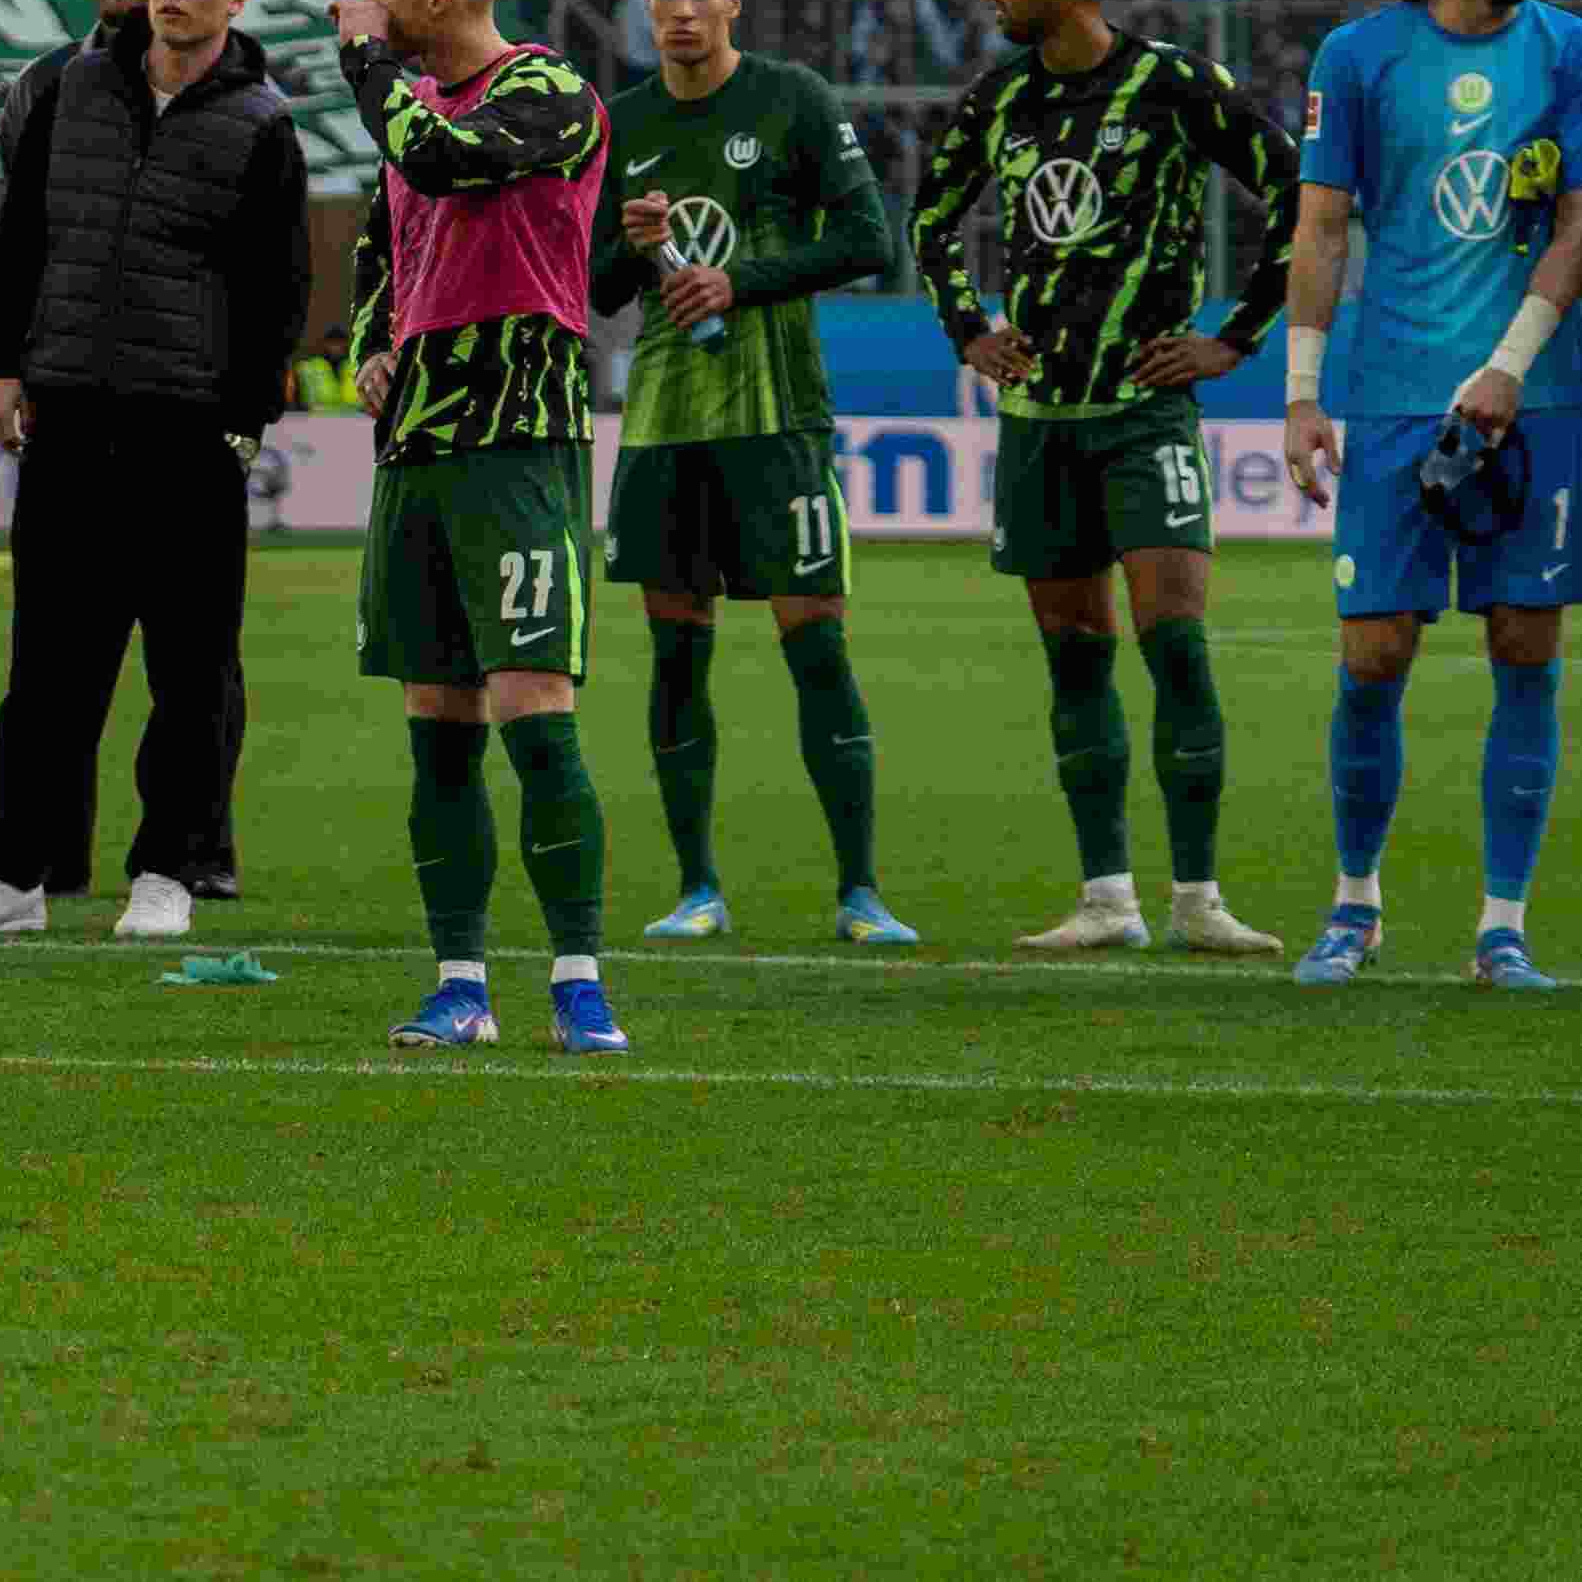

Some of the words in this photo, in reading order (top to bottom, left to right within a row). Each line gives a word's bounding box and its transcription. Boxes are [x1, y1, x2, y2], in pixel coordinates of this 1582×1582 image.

[1153, 444, 1200, 505] 15
[789, 495, 832, 556] 11
[499, 550, 555, 620] 27
